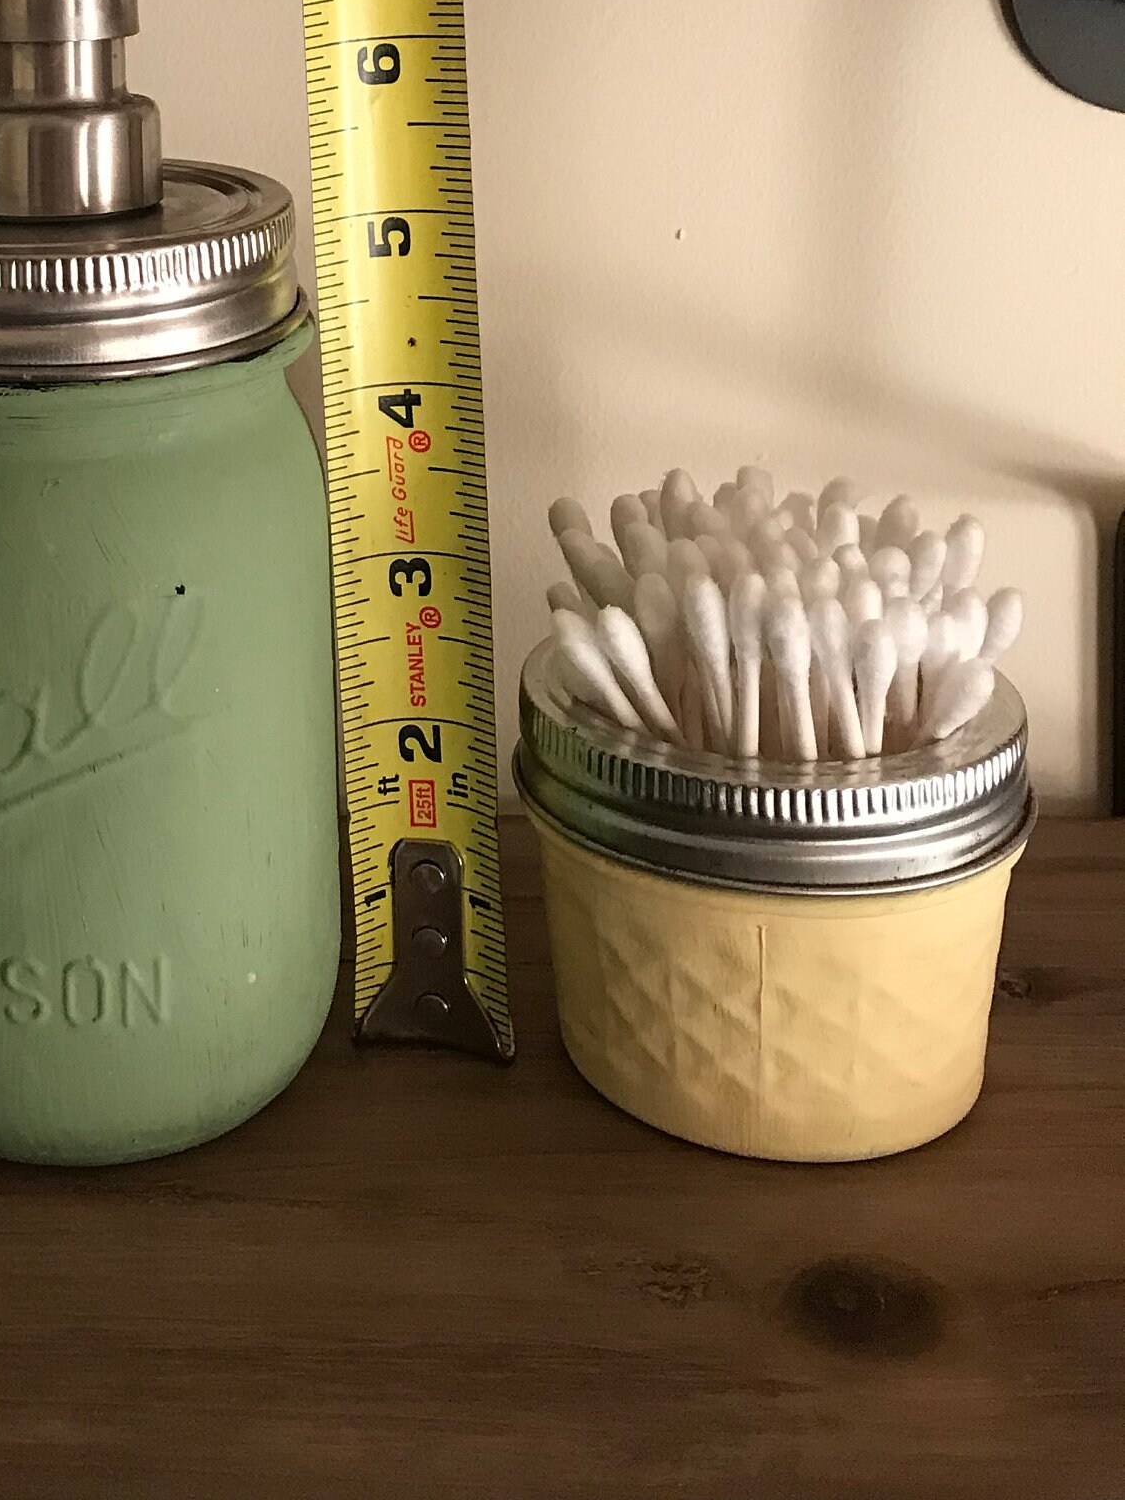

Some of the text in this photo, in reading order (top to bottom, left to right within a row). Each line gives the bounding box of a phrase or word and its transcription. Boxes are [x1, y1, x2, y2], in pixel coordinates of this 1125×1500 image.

[357, 43, 401, 86] 6
[367, 216, 411, 258] 5
[378, 388, 422, 429] 4
[386, 436, 408, 501] Guard
[389, 557, 432, 597] 3
[405, 621, 427, 708] STANLEY
[398, 724, 443, 764] 2
[377, 772, 400, 796] ft
[415, 785, 433, 821] 25ft
[446, 771, 469, 798] in
[364, 889, 387, 907] 1
[469, 894, 492, 911] 1
